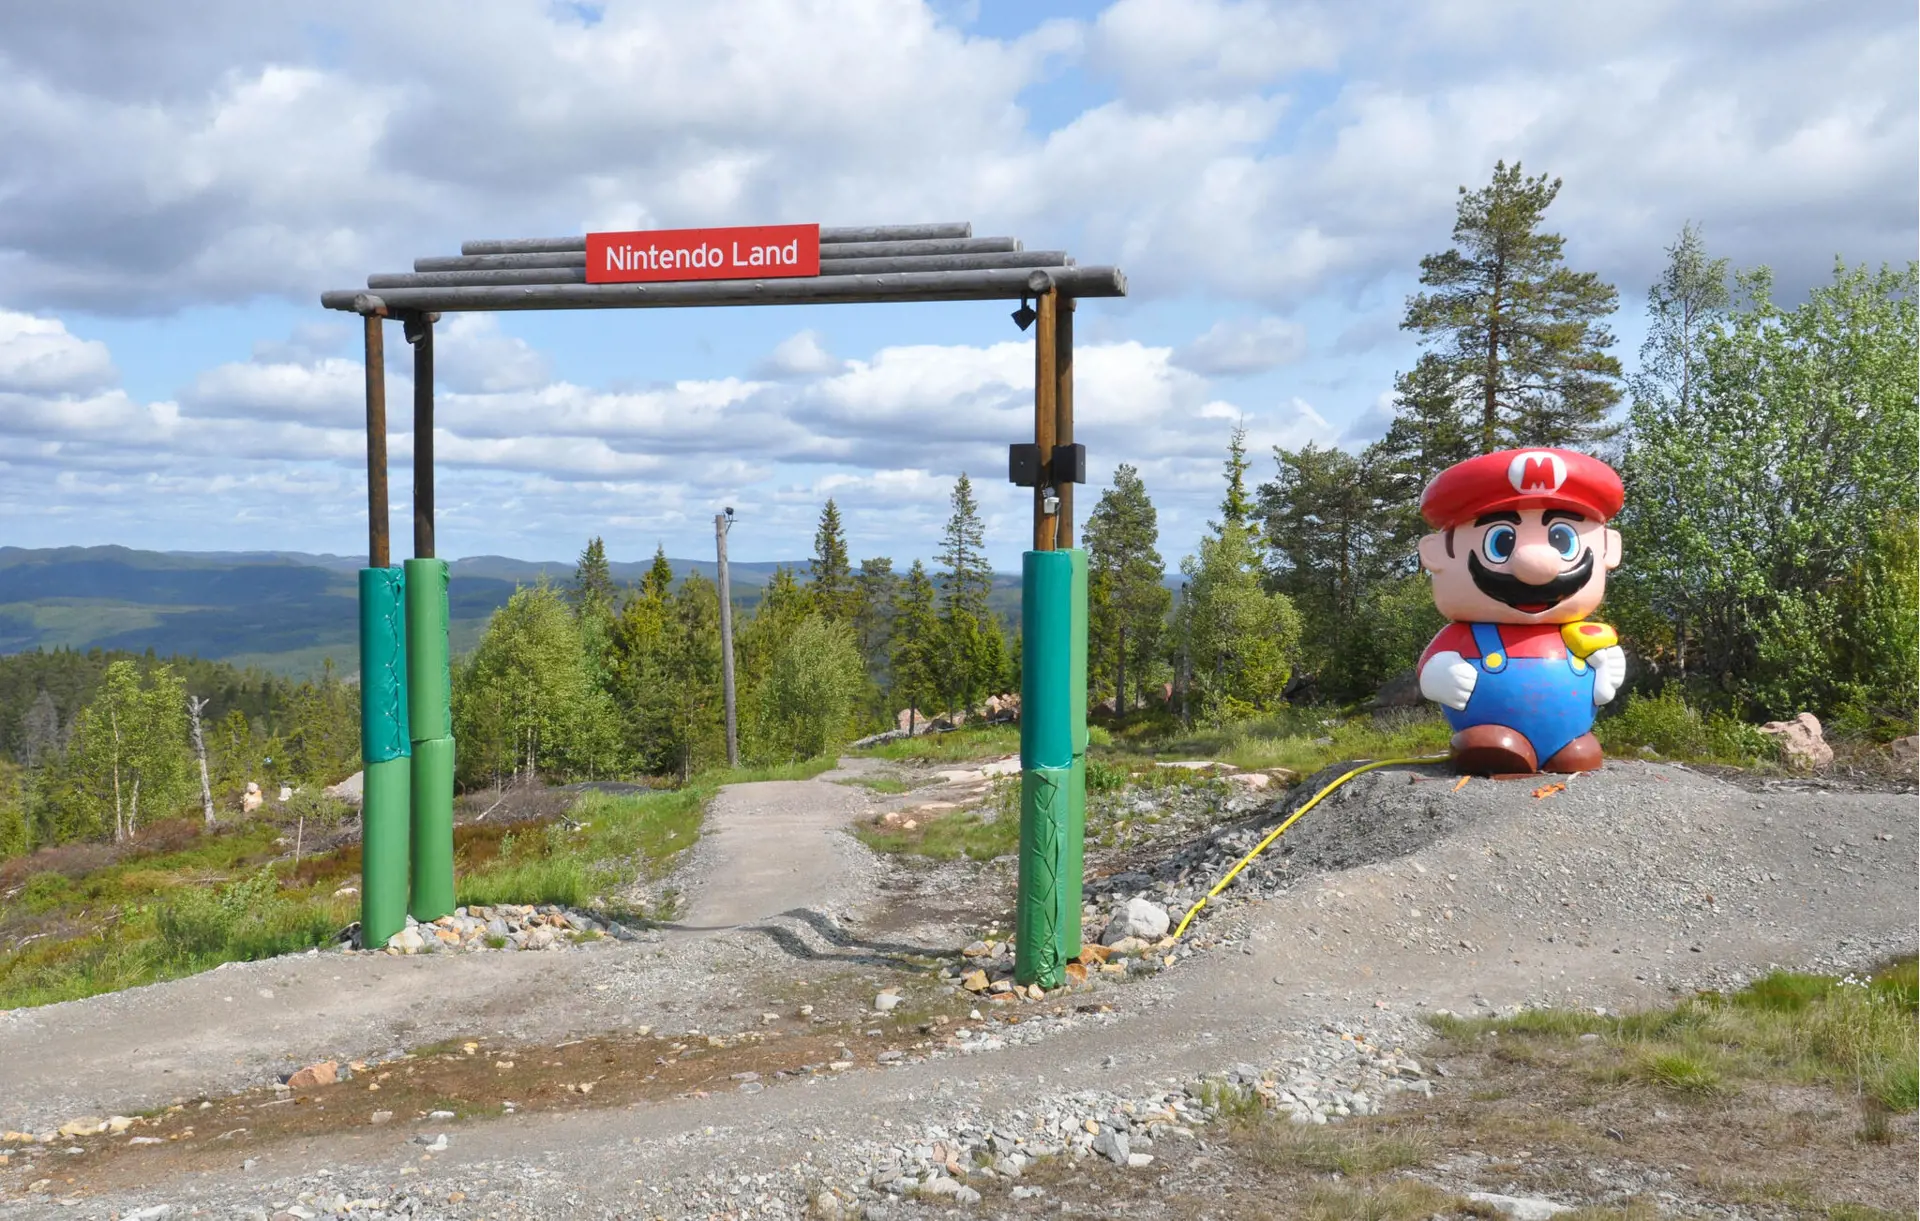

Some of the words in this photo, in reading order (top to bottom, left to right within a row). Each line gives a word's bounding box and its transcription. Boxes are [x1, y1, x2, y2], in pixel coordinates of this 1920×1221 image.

[606, 242, 724, 271] Nintendo
[732, 239, 798, 266] Land
[1520, 457, 1555, 489] M
